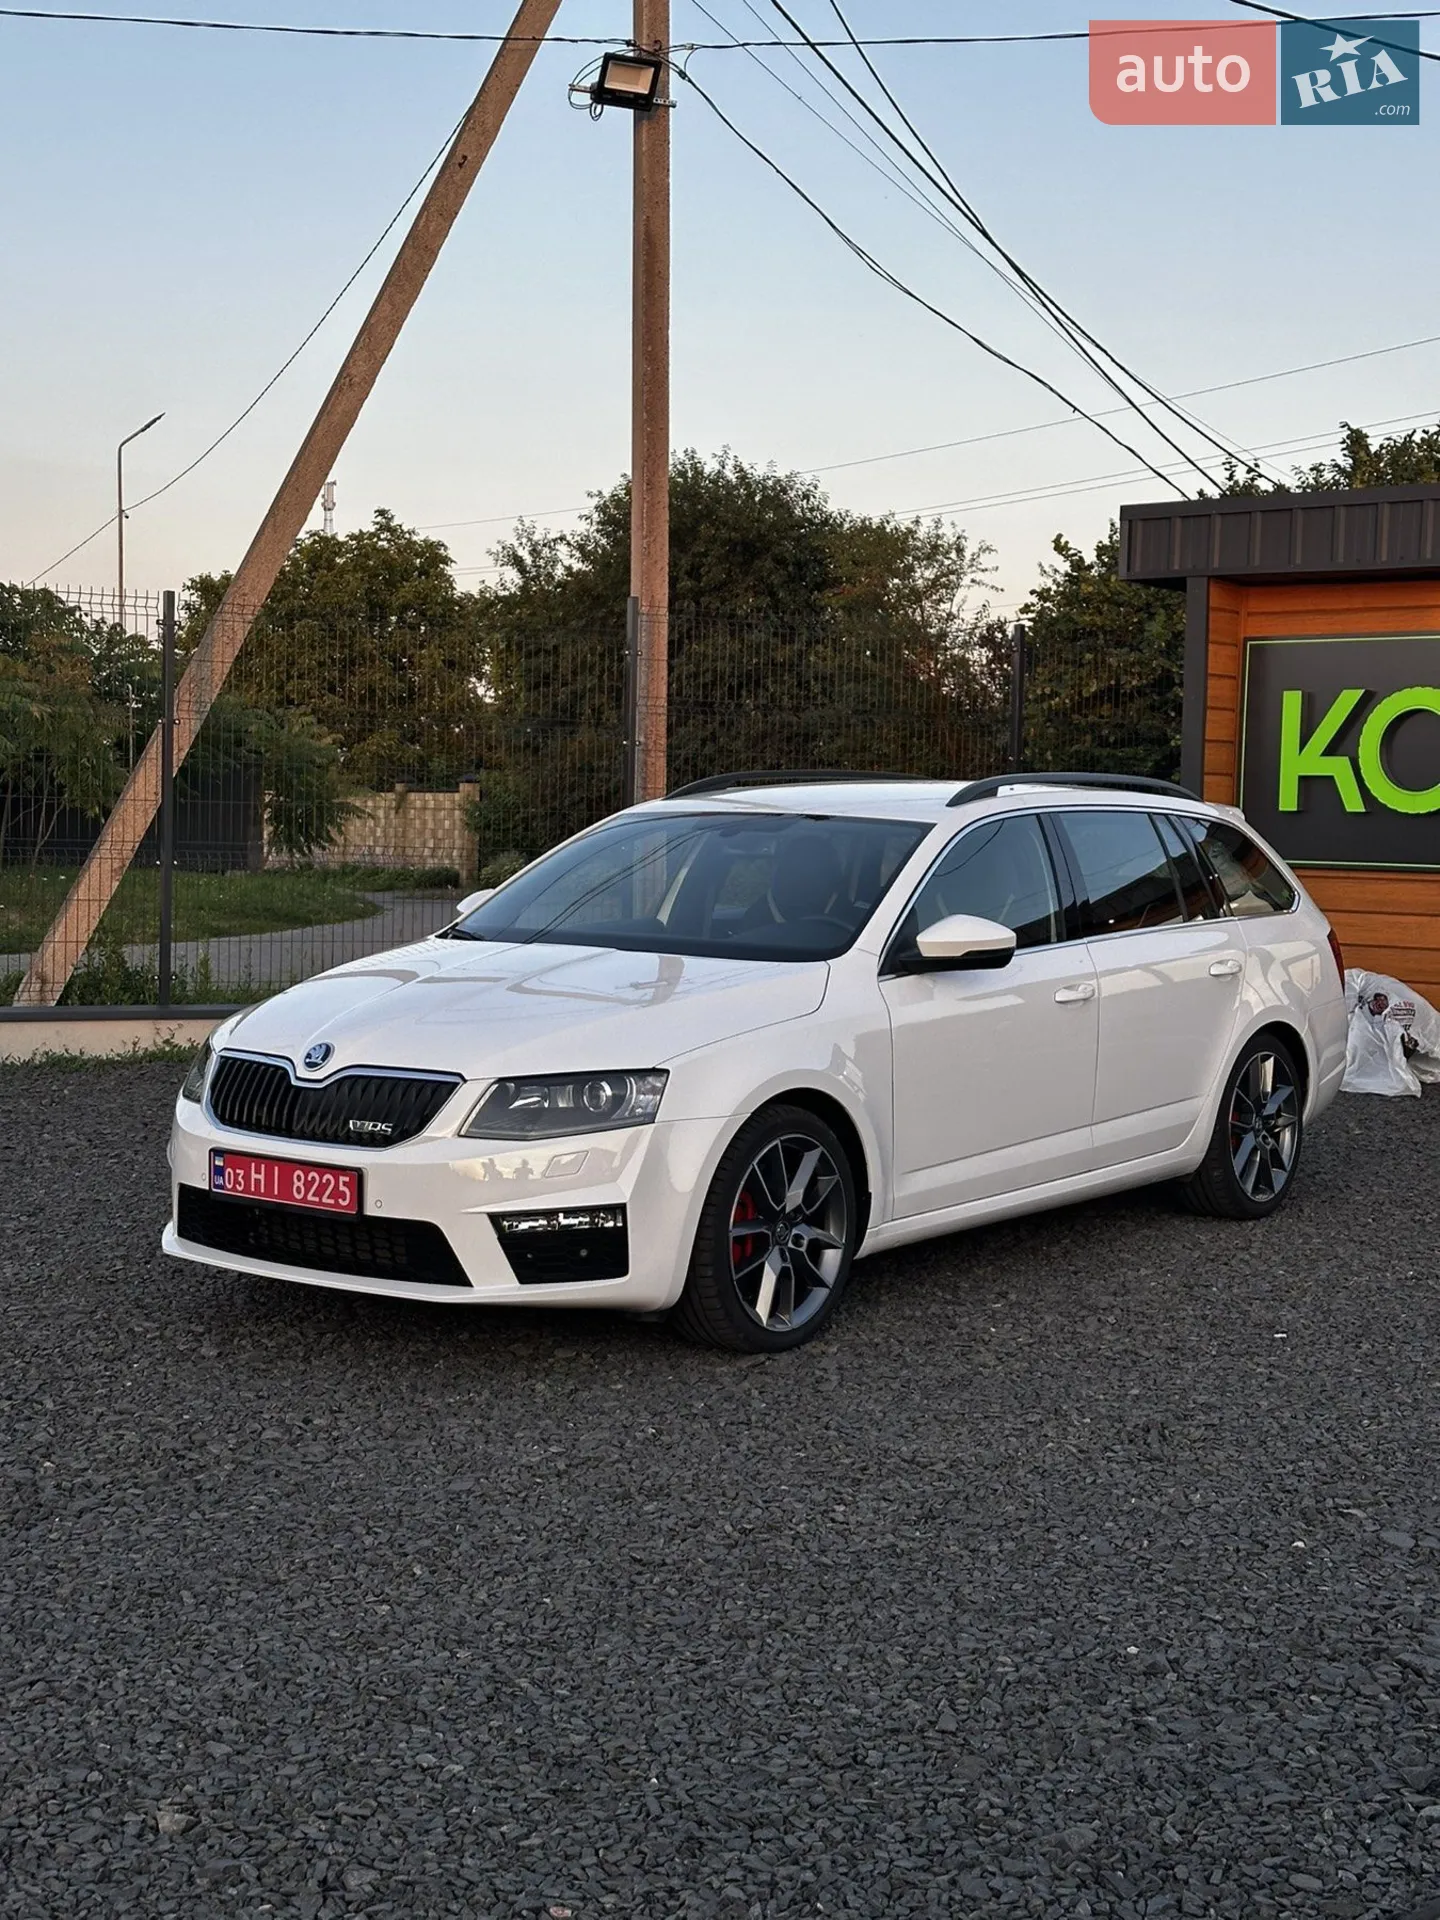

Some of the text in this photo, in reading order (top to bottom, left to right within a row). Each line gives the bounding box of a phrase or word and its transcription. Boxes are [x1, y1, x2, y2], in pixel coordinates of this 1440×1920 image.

[214, 1176, 224, 1185] UA
[225, 1167, 245, 1191] 03
[293, 1169, 351, 1207] 8225
